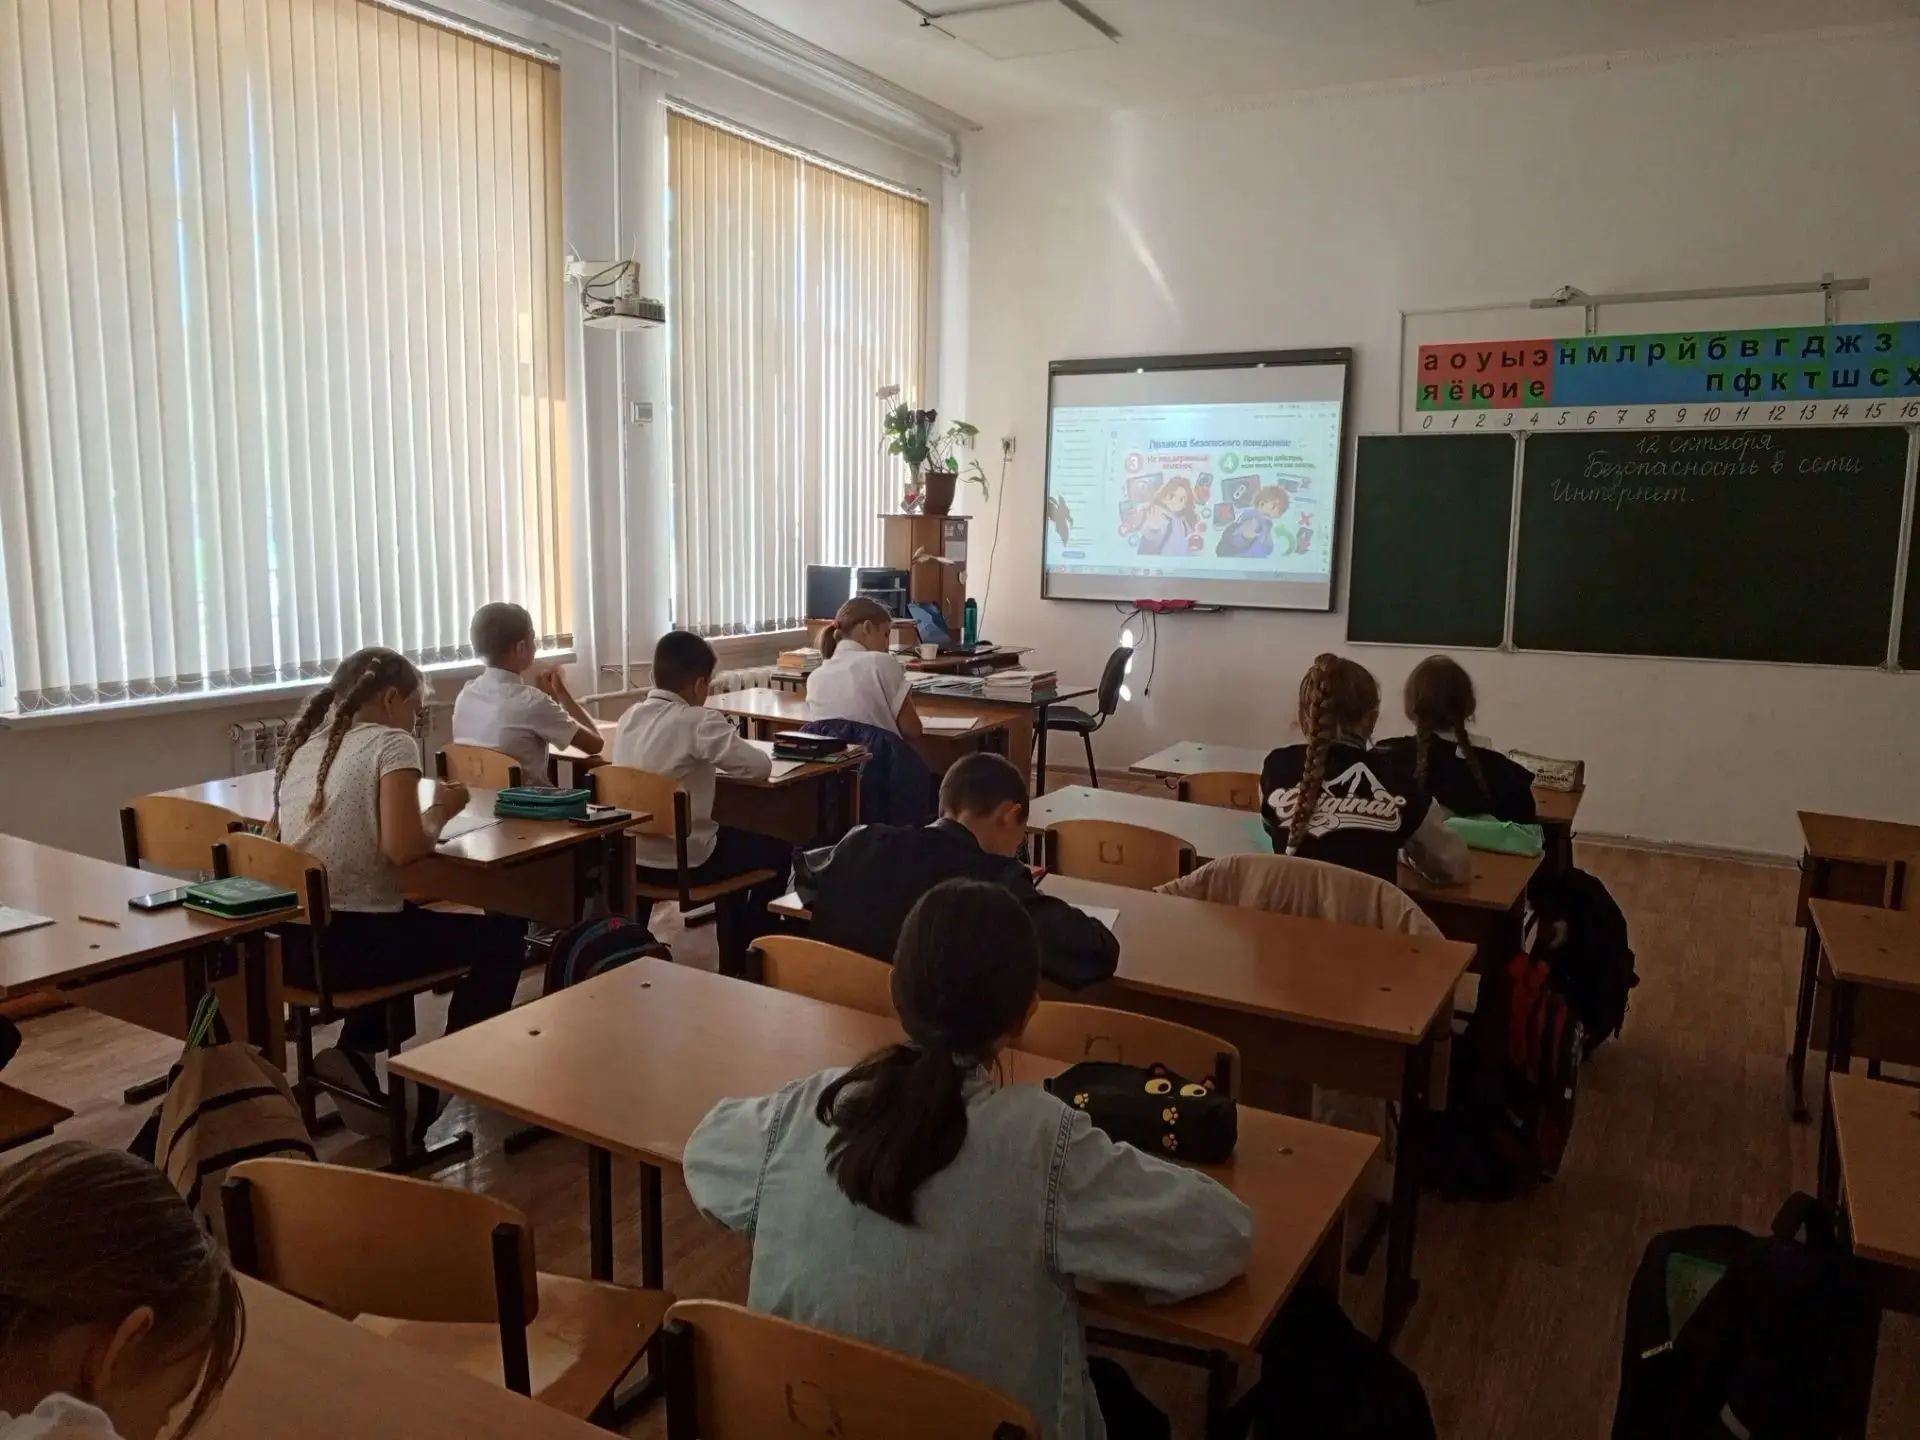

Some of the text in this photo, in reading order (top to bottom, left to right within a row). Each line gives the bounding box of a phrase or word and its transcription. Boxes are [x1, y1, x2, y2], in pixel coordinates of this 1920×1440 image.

[1424, 333, 1892, 372] а о у ы э н м л р й б в г д ж з
[1423, 367, 1920, 400] я ё ю и е п ф к т ш с х
[1422, 402, 1919, 429] 0 1 2 3 4 5 6 7 8 9 10 11 12 13 14 15 16
[1636, 435, 1660, 453] 12
[1584, 450, 1759, 487] Безопасность
[1268, 783, 1406, 824] Oiginal
